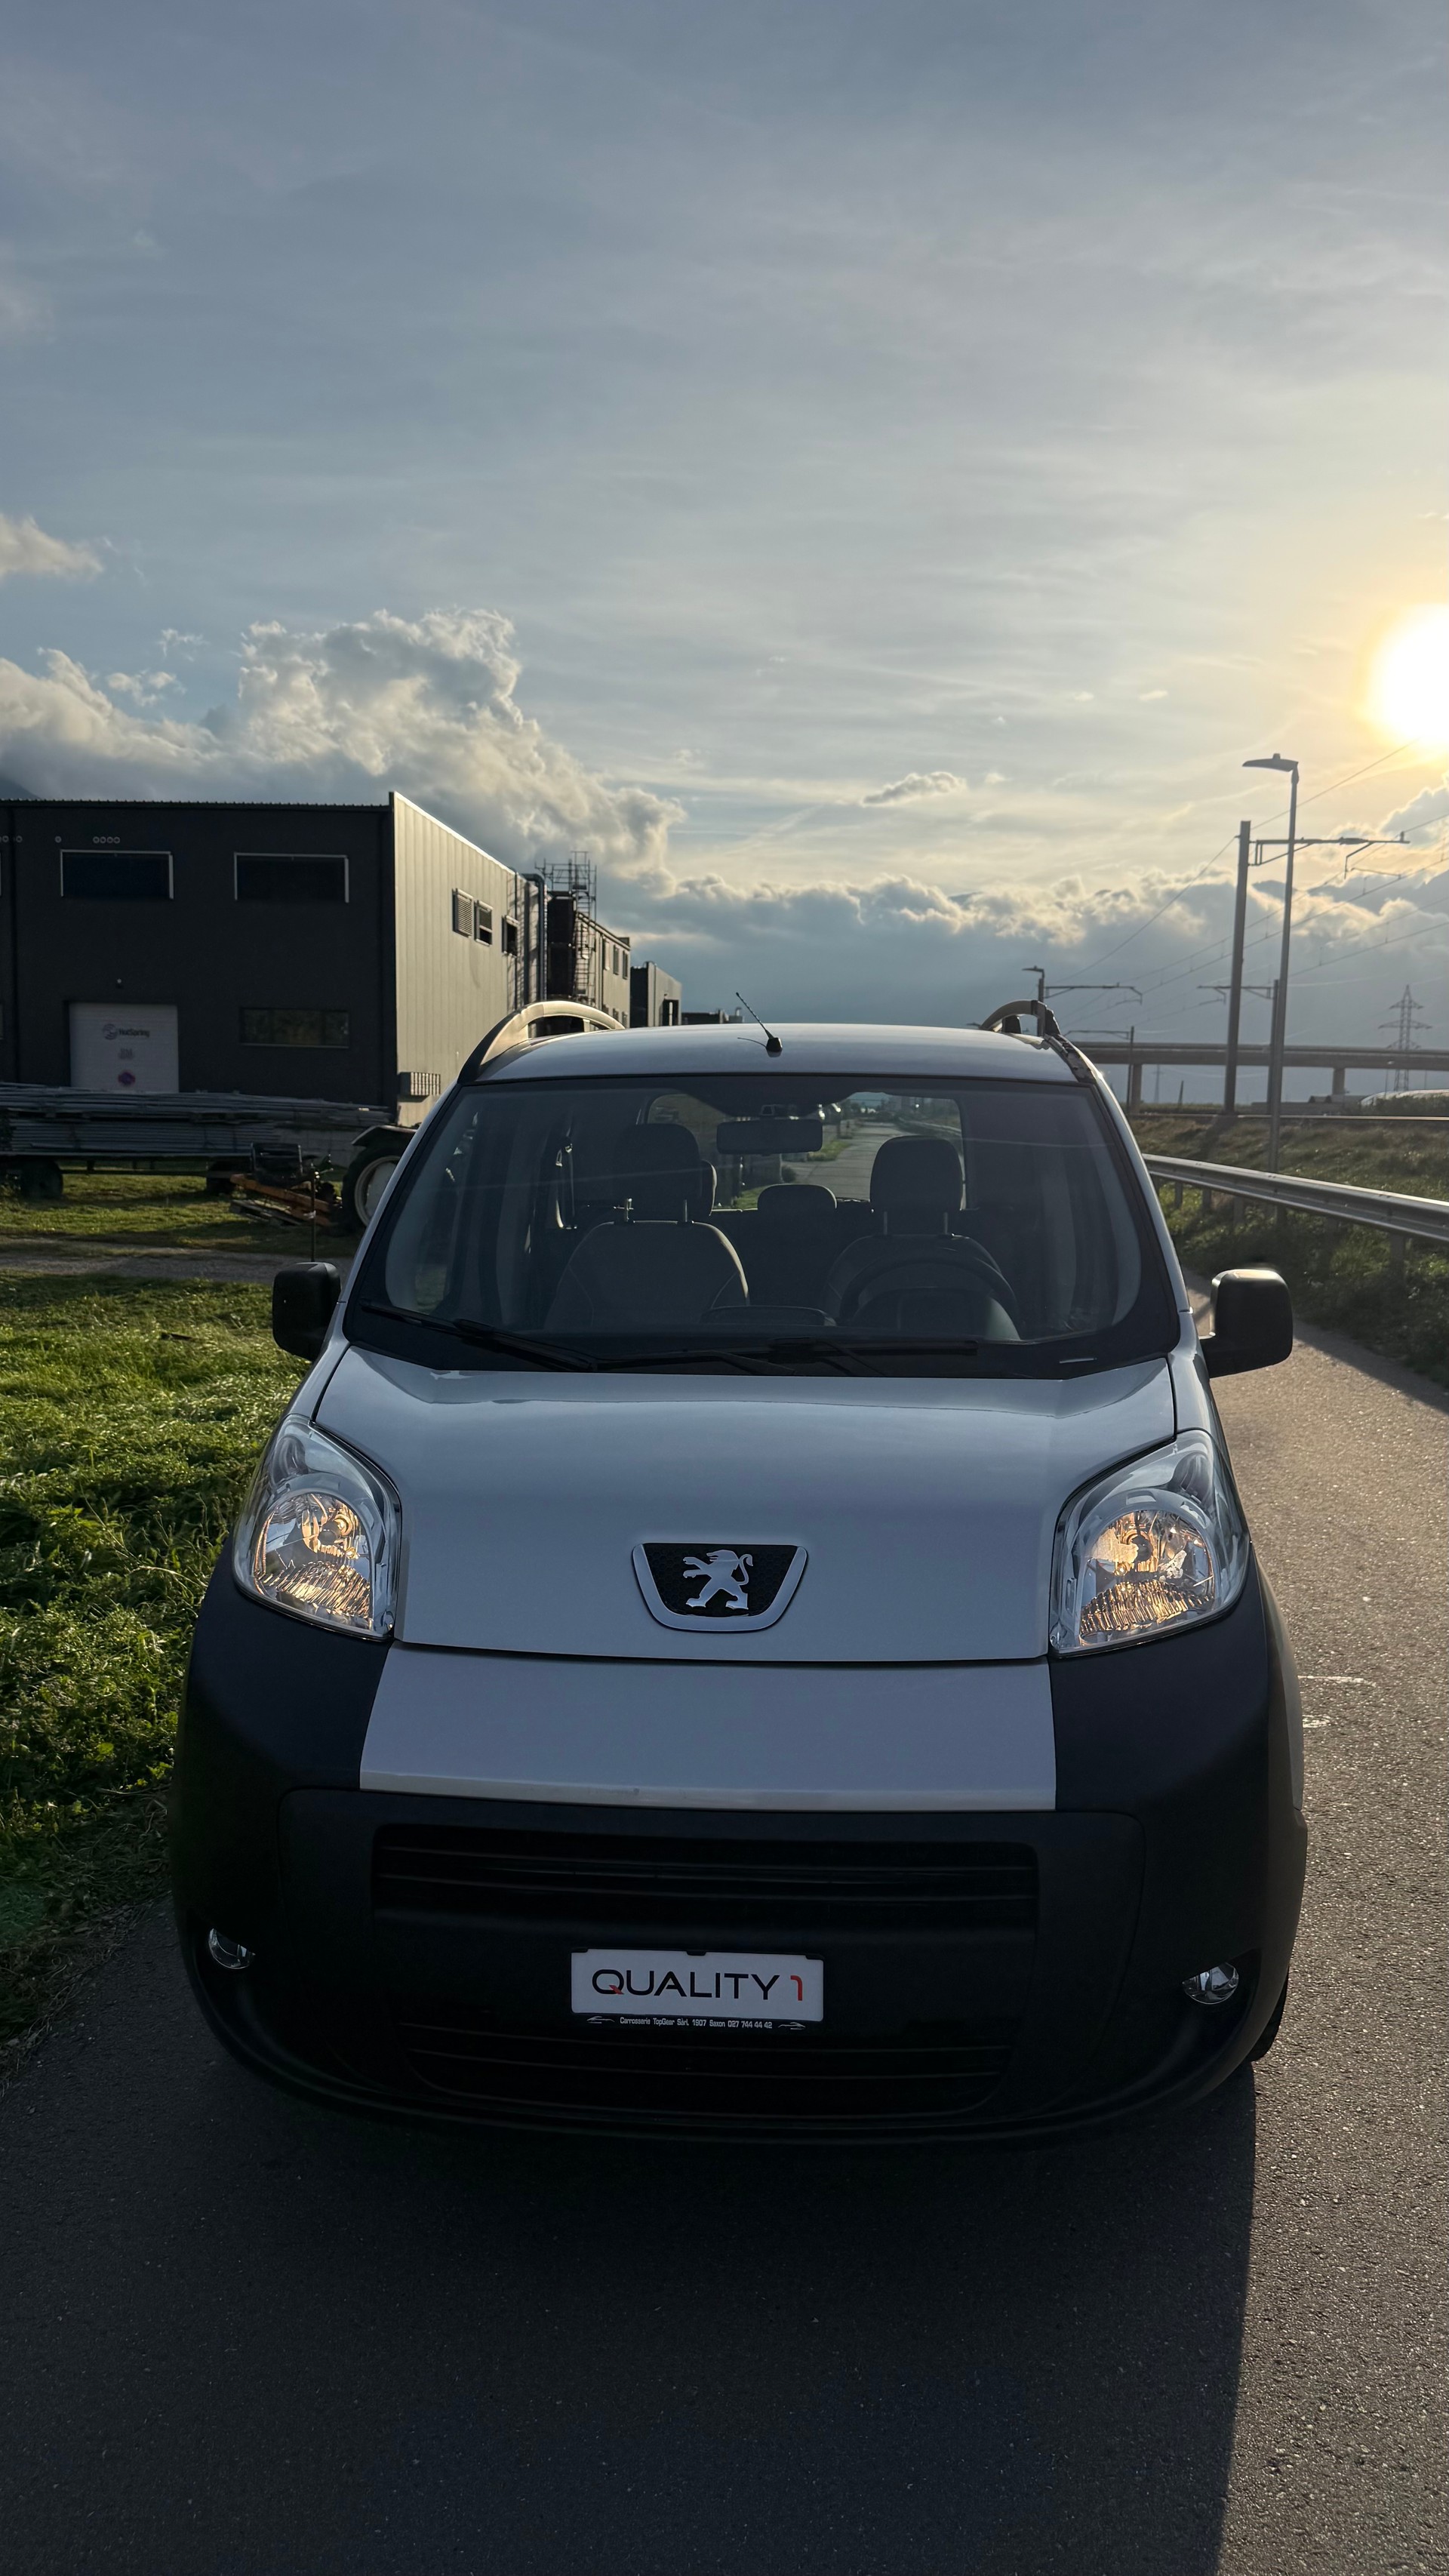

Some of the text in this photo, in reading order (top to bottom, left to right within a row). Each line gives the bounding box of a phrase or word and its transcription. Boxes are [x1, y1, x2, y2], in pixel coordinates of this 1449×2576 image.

[592, 1968, 803, 2002] QUALITY 1
[620, 2017, 650, 2025] Carrosserie
[653, 2017, 675, 2027] TopGear
[728, 2020, 740, 2028] 027
[740, 2020, 752, 2029] 744
[753, 2020, 763, 2029] 44
